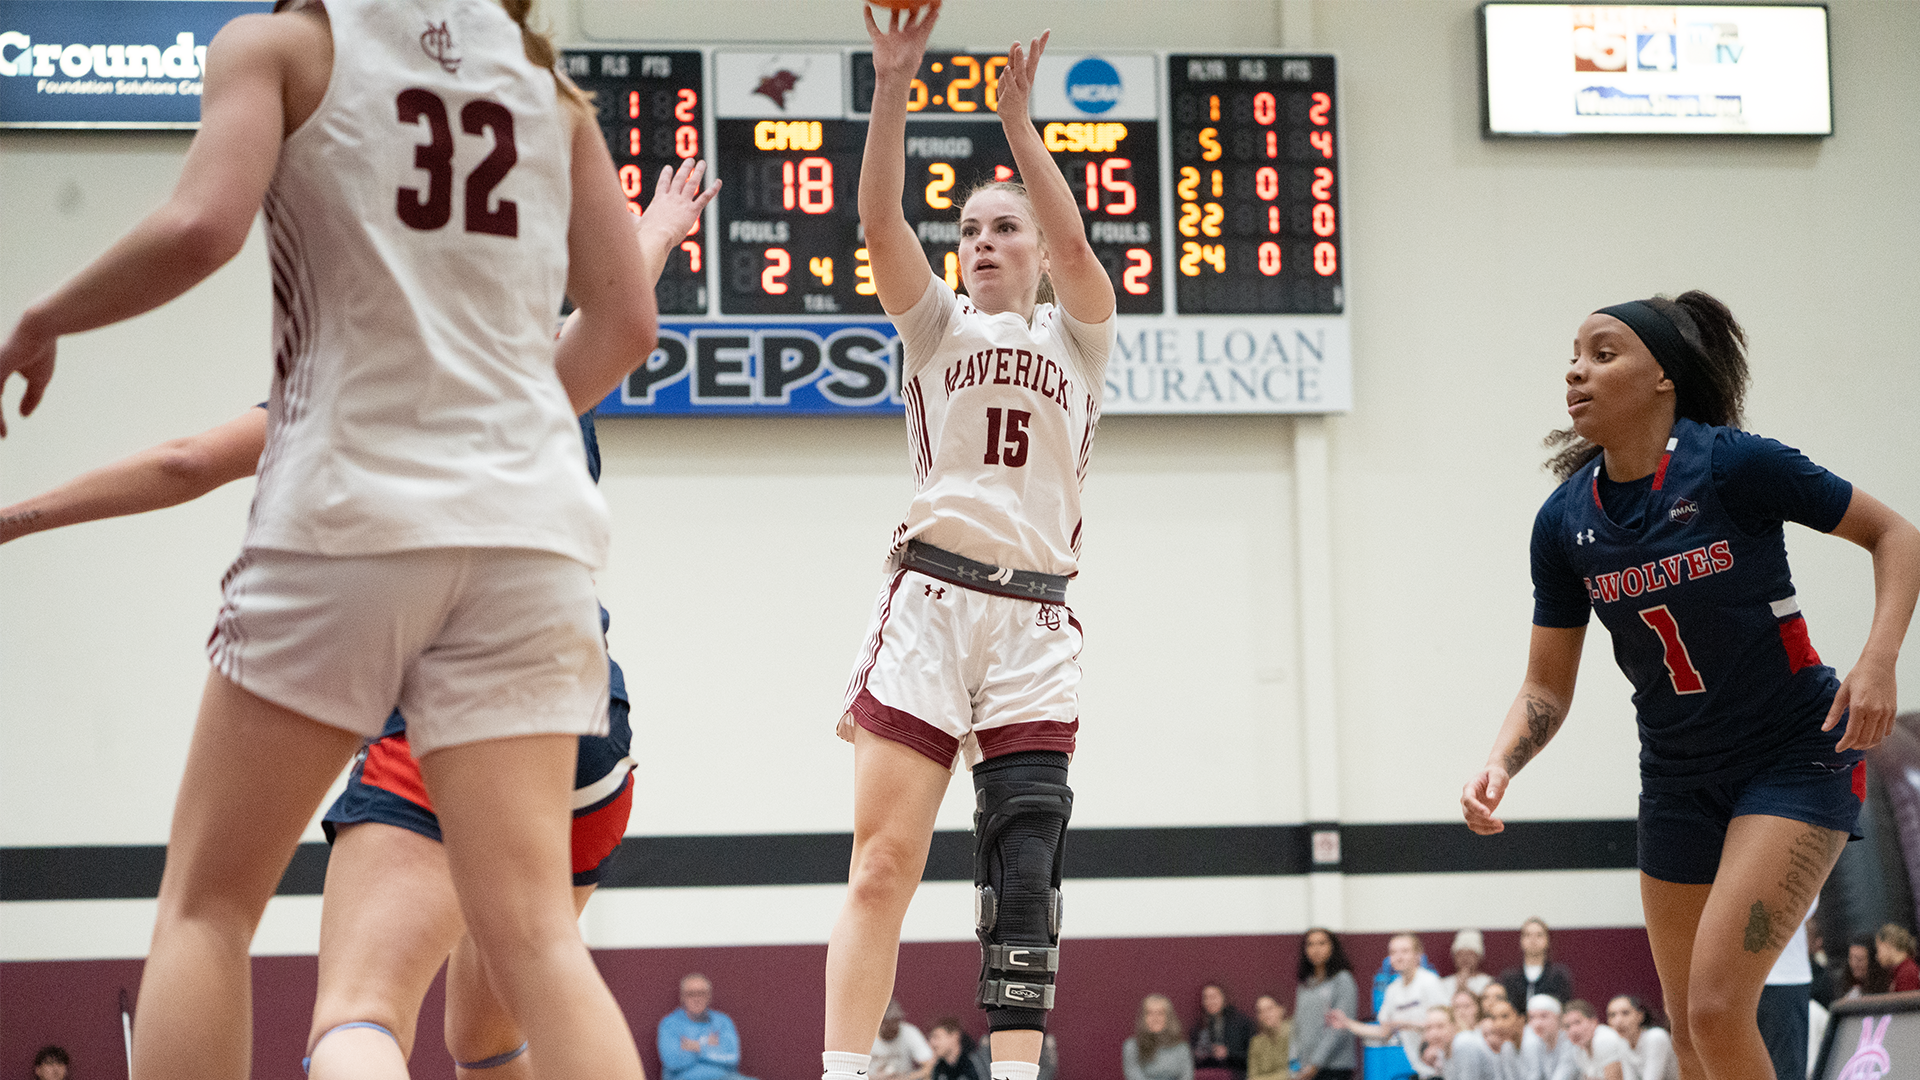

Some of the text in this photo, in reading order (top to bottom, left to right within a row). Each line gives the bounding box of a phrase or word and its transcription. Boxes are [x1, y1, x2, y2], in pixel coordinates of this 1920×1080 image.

[37, 79, 114, 95] Foundation
[115, 80, 177, 95] Solutions
[629, 88, 697, 122] 1 2
[1209, 91, 1332, 126] 1 0 2
[630, 125, 698, 159] 1 0
[754, 121, 823, 151] CMU
[907, 137, 974, 159] PERIOD
[1043, 122, 1128, 153] CSUP
[1199, 127, 1333, 162] 5 1 4
[396, 88, 518, 239] 32
[619, 164, 642, 199] 0
[782, 157, 834, 215] 18
[925, 162, 956, 210] 2
[1086, 158, 1137, 215] 15
[1177, 165, 1334, 201] 21 0 2
[730, 221, 790, 243] FOULS
[1091, 222, 1151, 245] FOULS
[1178, 202, 1336, 238] 22 1 0
[681, 240, 702, 273] 7
[761, 248, 791, 295] 2
[809, 256, 834, 287] 4
[1123, 248, 1153, 295] 2
[1179, 241, 1337, 277] 24 0 0
[1196, 328, 1326, 365] LOAN
[944, 347, 1074, 417] MAVERICK
[1105, 366, 1323, 403] SURANCE
[983, 406, 1032, 468] 15
[1670, 503, 1698, 519] RMAC
[1637, 603, 1707, 696] 1
